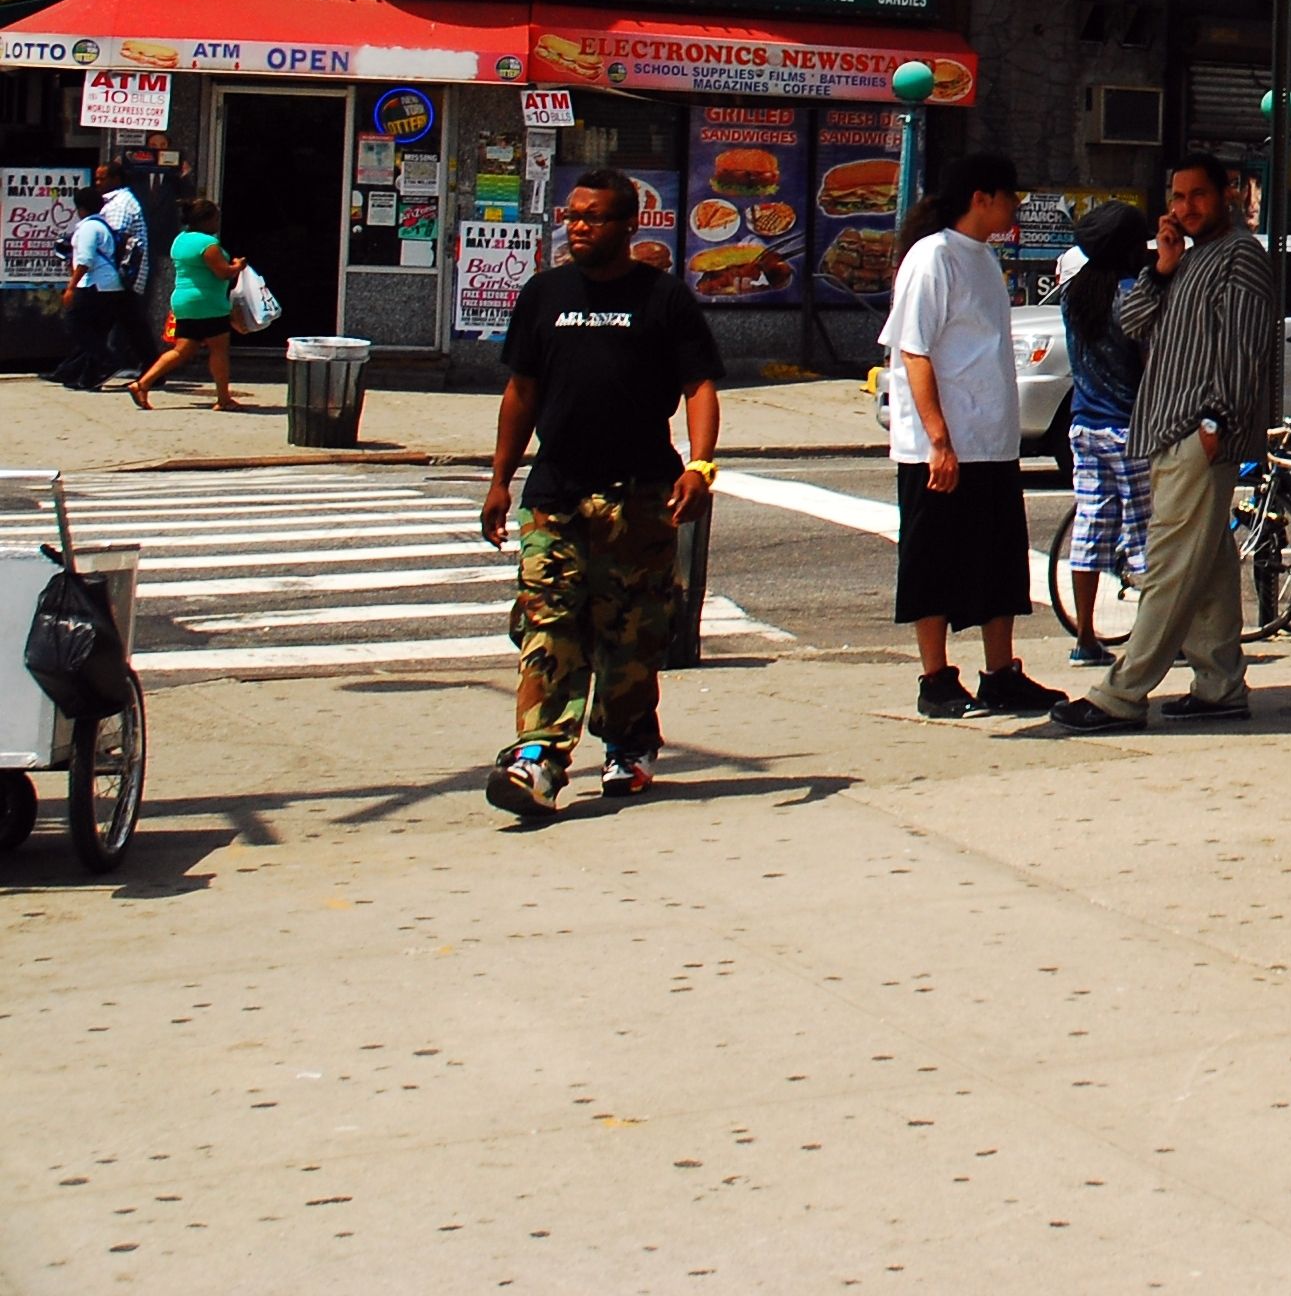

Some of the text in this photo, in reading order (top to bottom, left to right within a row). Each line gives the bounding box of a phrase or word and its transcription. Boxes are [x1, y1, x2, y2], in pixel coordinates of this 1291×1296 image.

[5, 42, 66, 60] LOTTO
[193, 43, 349, 72] ATM OPEN
[580, 37, 767, 66] ELECTRONICS
[91, 71, 167, 92] ATM
[633, 63, 886, 88] SCHOOL SUPPLIES FILMS BATTERIES
[693, 79, 831, 96] MAGAZINES COFFEE
[131, 93, 165, 104] BILLS
[525, 93, 569, 109] ATM
[112, 107, 145, 115] EXPRESS
[551, 111, 571, 122] BILLS
[705, 107, 794, 126] GRILLED
[828, 111, 874, 126] FRESH
[90, 115, 160, 127] 917-440-1779
[702, 128, 797, 144] SANDWICHES
[820, 130, 902, 145] SANDWICH
[8, 175, 81, 186] FRIDAY
[8, 207, 49, 223] Bad
[1020, 211, 1062, 222] MARCH
[12, 222, 59, 239] Girls
[466, 258, 503, 274] Bad
[469, 273, 512, 290] Girls
